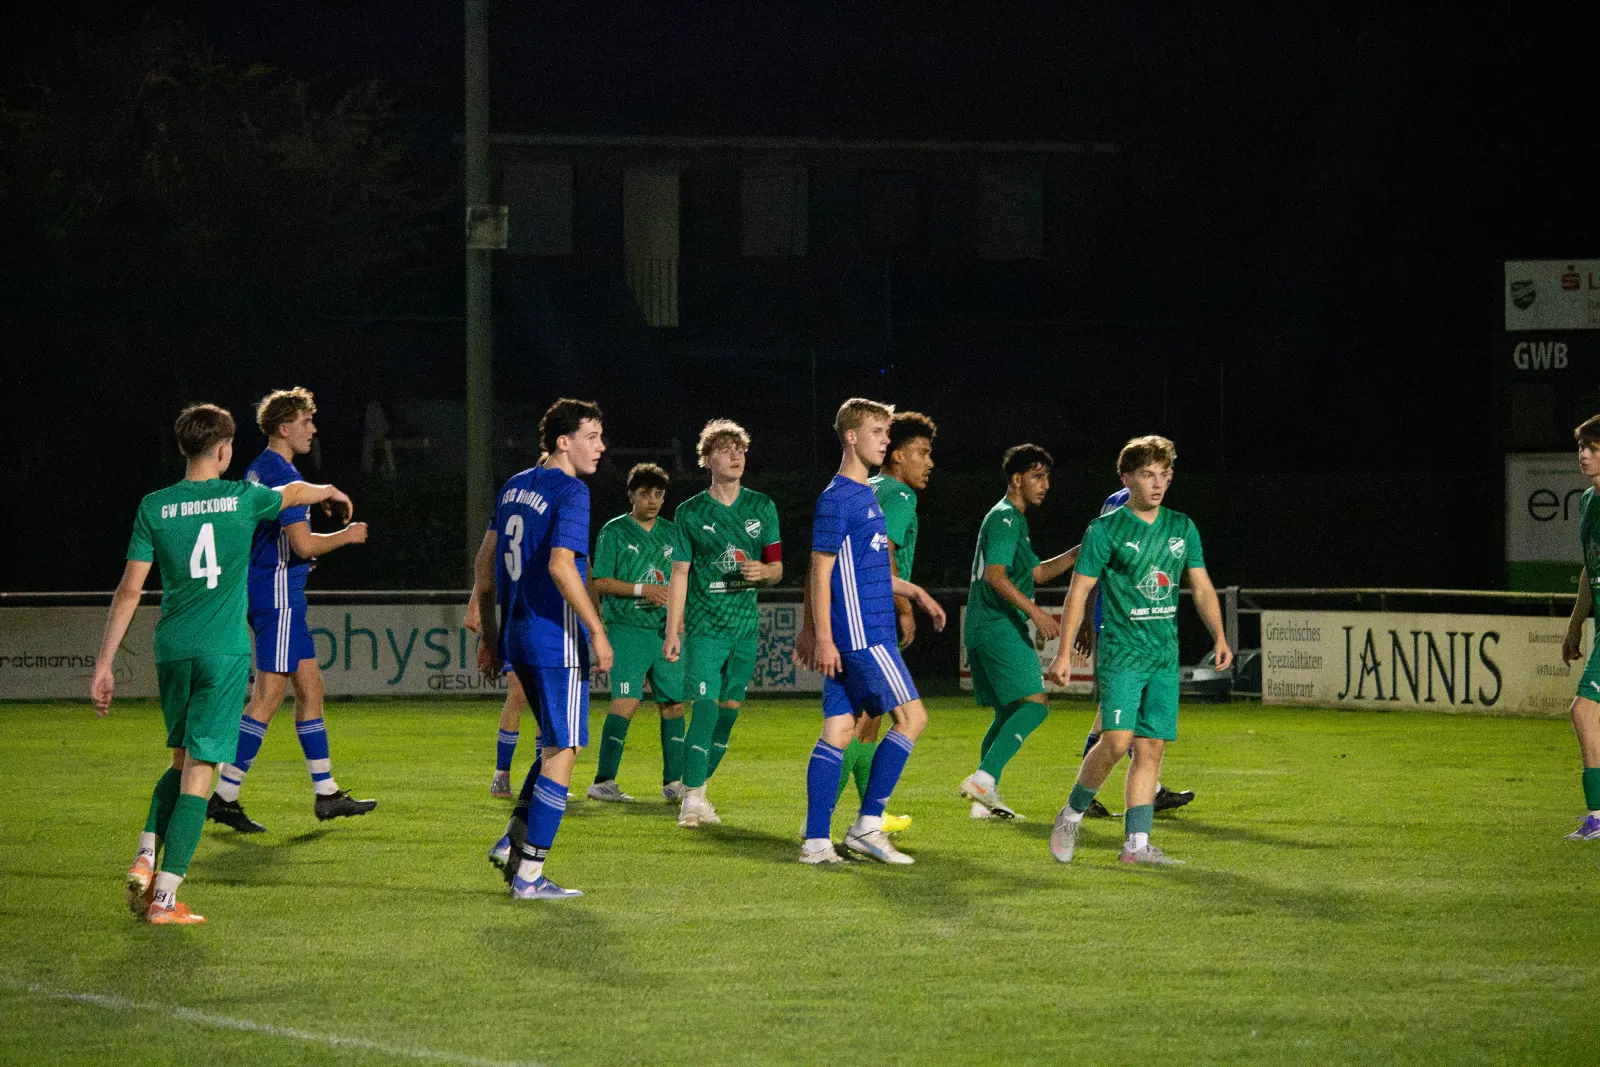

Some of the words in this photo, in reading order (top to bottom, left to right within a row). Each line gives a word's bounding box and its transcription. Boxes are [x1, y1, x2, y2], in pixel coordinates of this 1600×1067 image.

[1514, 341, 1568, 370] GWB
[161, 503, 178, 519] GW
[181, 496, 239, 516] BROCKDORF
[190, 522, 222, 589] 4
[504, 514, 524, 581] 3
[1266, 621, 1321, 642] Griechisches
[1267, 651, 1323, 675] Spezialitäten
[1337, 625, 1502, 707] JANNIS
[620, 682, 630, 695] 18
[1267, 678, 1315, 698] Restaurant
